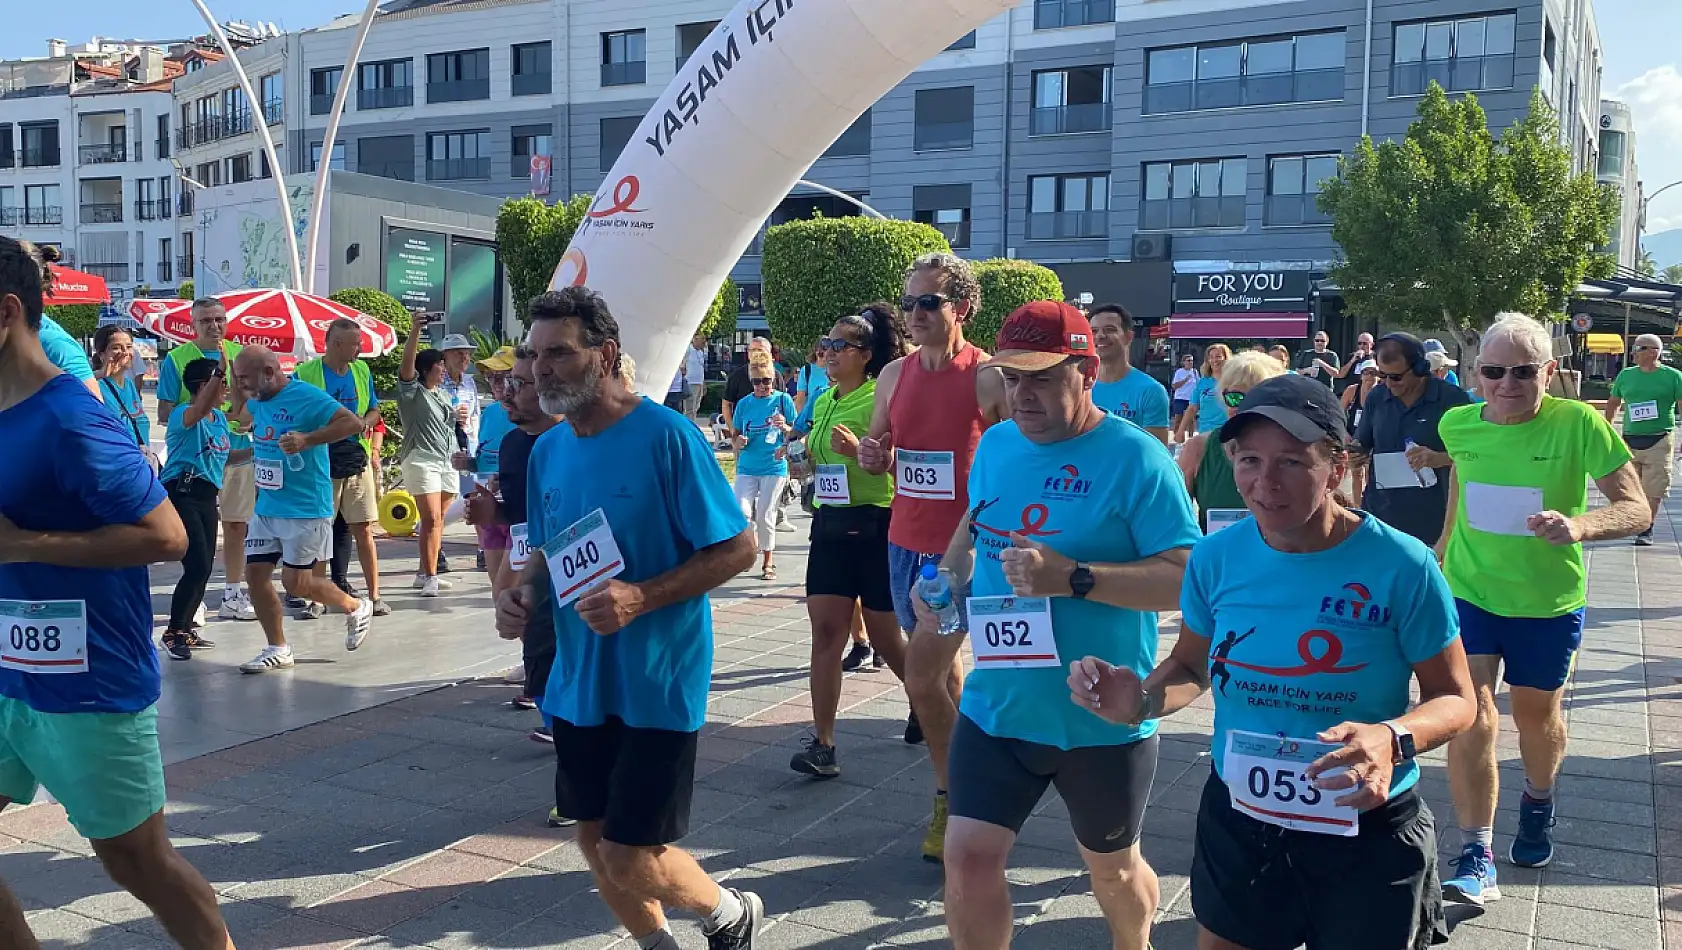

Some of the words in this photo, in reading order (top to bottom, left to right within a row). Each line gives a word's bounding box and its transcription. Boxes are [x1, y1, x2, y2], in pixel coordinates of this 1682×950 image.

[646, 32, 741, 157] YAŞAM
[60, 282, 88, 291] Mucize
[1198, 274, 1236, 292] FOR
[1241, 273, 1284, 292] YOU
[1216, 293, 1263, 310] Boutique
[1635, 408, 1651, 416] 071
[256, 468, 274, 481] 039
[904, 466, 938, 486] 063
[819, 476, 840, 493] 035
[1043, 476, 1093, 494] FETAY
[562, 540, 600, 579] 040
[10, 624, 61, 652] 088
[984, 620, 1033, 648] 052
[1247, 696, 1281, 708] RACE
[1284, 701, 1311, 713] FOR
[1314, 705, 1342, 715] LIFE
[1248, 765, 1322, 805] 053
